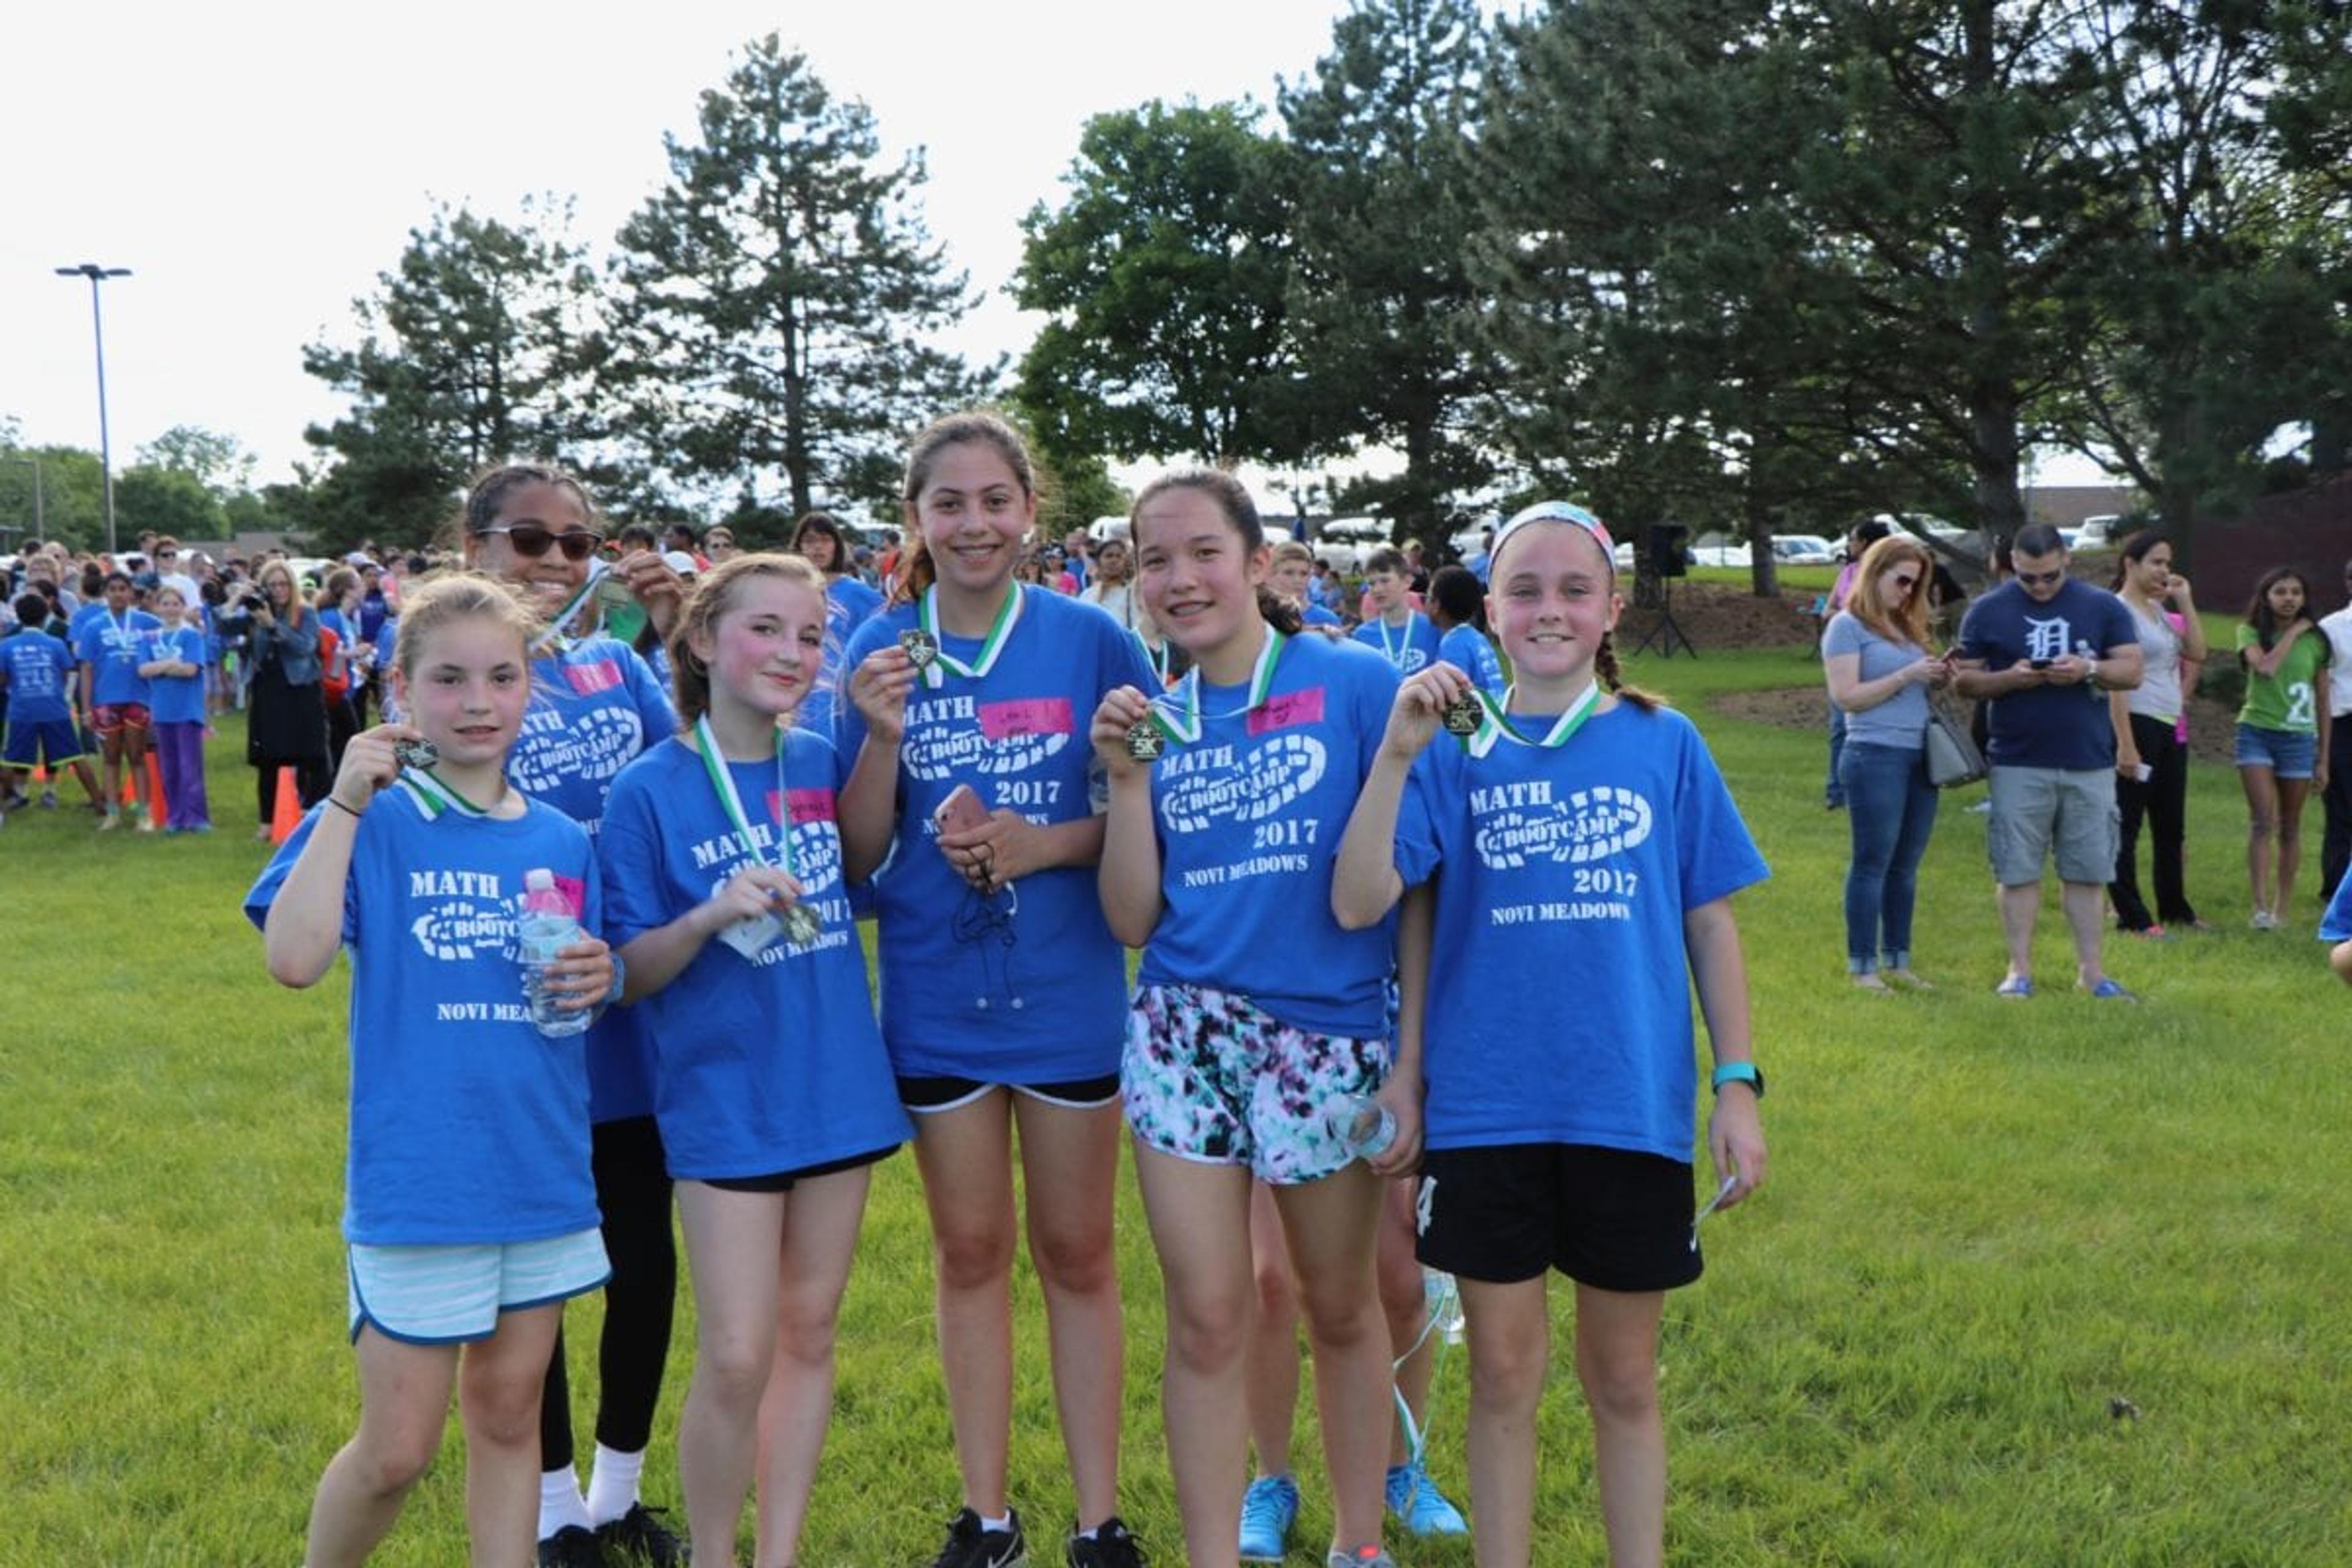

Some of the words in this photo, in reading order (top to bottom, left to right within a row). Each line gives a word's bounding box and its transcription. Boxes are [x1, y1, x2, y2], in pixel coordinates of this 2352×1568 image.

[2023, 615, 2070, 661] D
[519, 710, 565, 737] ATH
[540, 733, 624, 769] BOOTCAMP
[1160, 745, 1234, 781] MATH
[995, 780, 1062, 805] 2017
[1189, 764, 1291, 810] BOOTCAMP
[1470, 780, 1552, 816] MATH
[1253, 819, 1318, 849] 2017
[1504, 816, 1621, 848] BOOTCAMP
[409, 871, 499, 899] MATH
[1183, 867, 1224, 887] NOVI
[1229, 854, 1309, 881] MEADOWS
[1574, 868, 1638, 897] 2017
[455, 920, 521, 938] BOOTC
[1490, 905, 1535, 926] NOVI
[1539, 902, 1630, 921] MEADOW
[437, 1003, 488, 1020] NOVI
